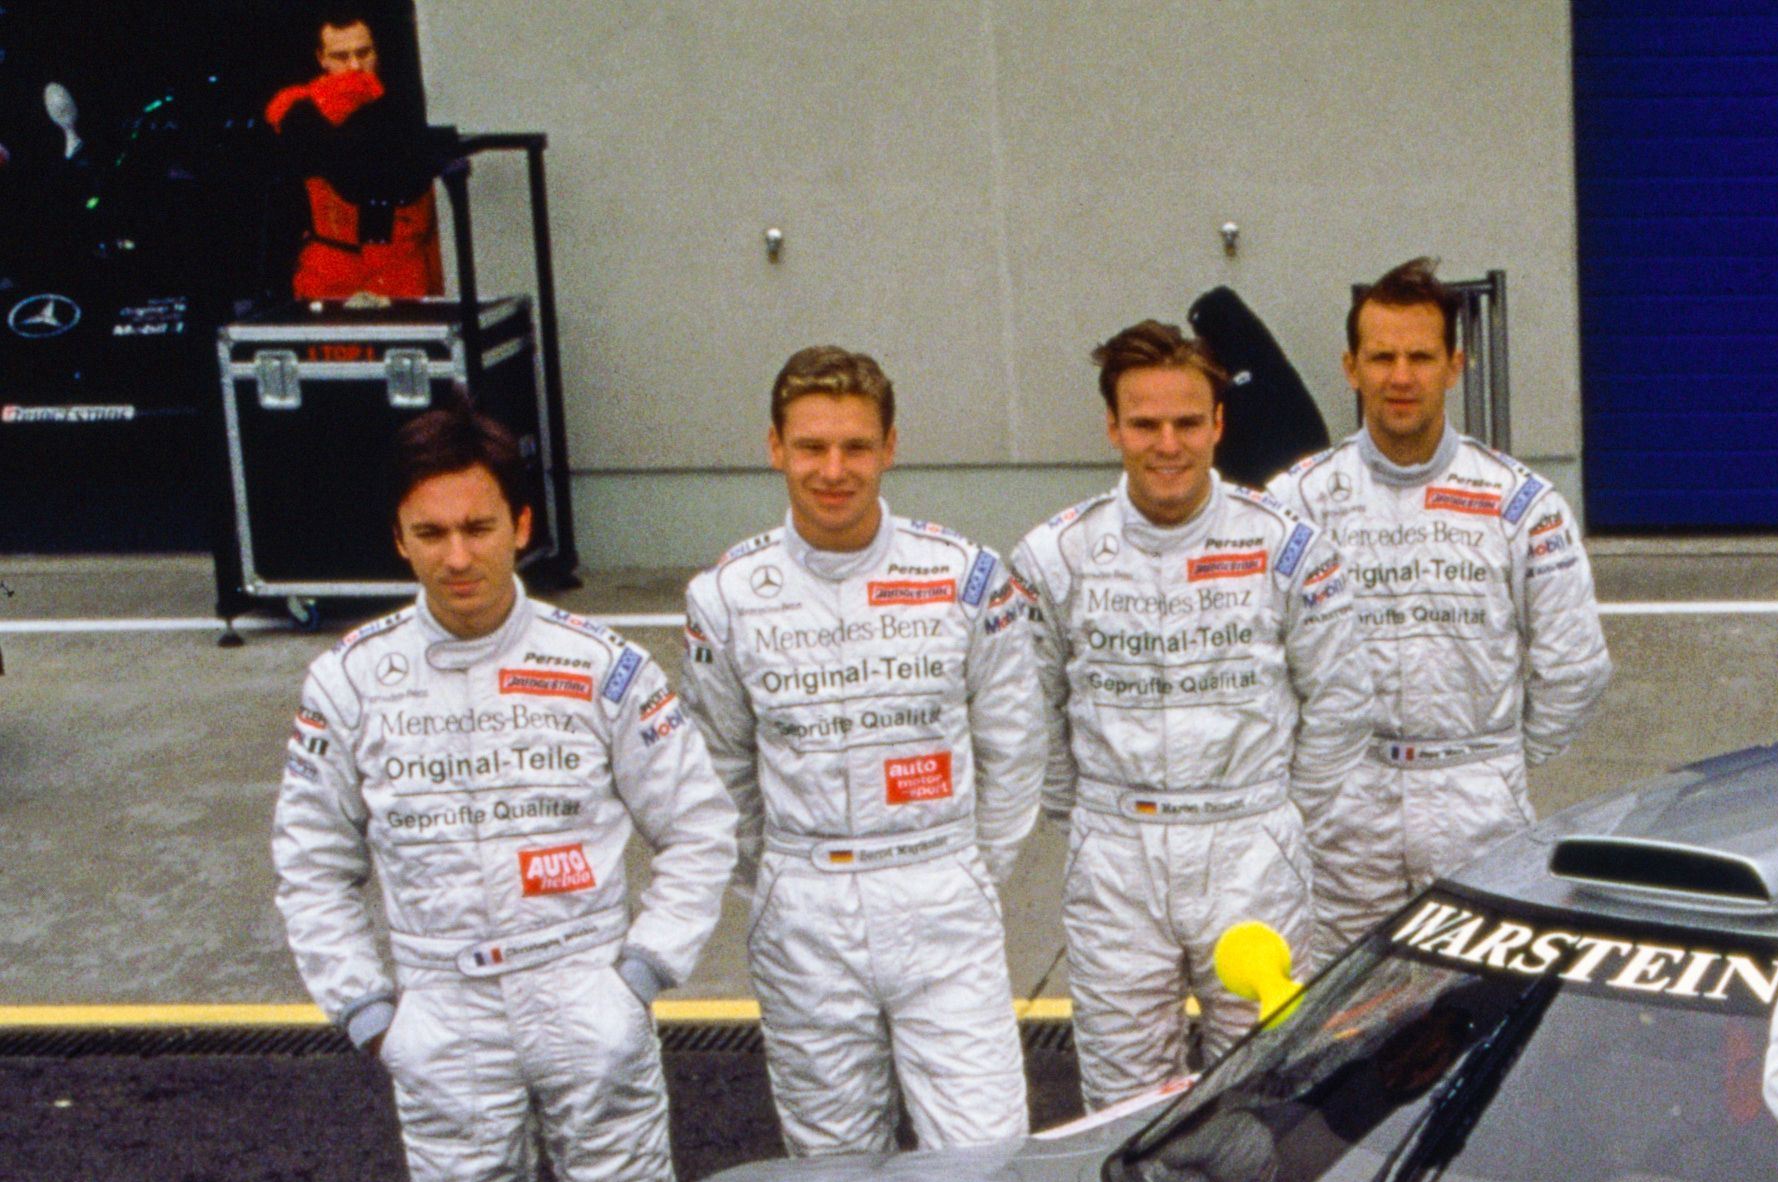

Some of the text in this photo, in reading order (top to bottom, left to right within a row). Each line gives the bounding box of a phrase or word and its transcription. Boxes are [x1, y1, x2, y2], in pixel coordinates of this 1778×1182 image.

[887, 563, 950, 575] Persson
[755, 613, 943, 654] Mercedes-Benz
[1088, 624, 1252, 655] Original-Teile
[524, 652, 593, 670] Persson
[762, 656, 944, 695] Original-Teile
[381, 704, 576, 737] Mercedes-Benz
[384, 745, 581, 784] Original-Teile
[889, 759, 938, 777] auto
[387, 804, 486, 832] Geprüfte
[527, 849, 586, 880] AUTO
